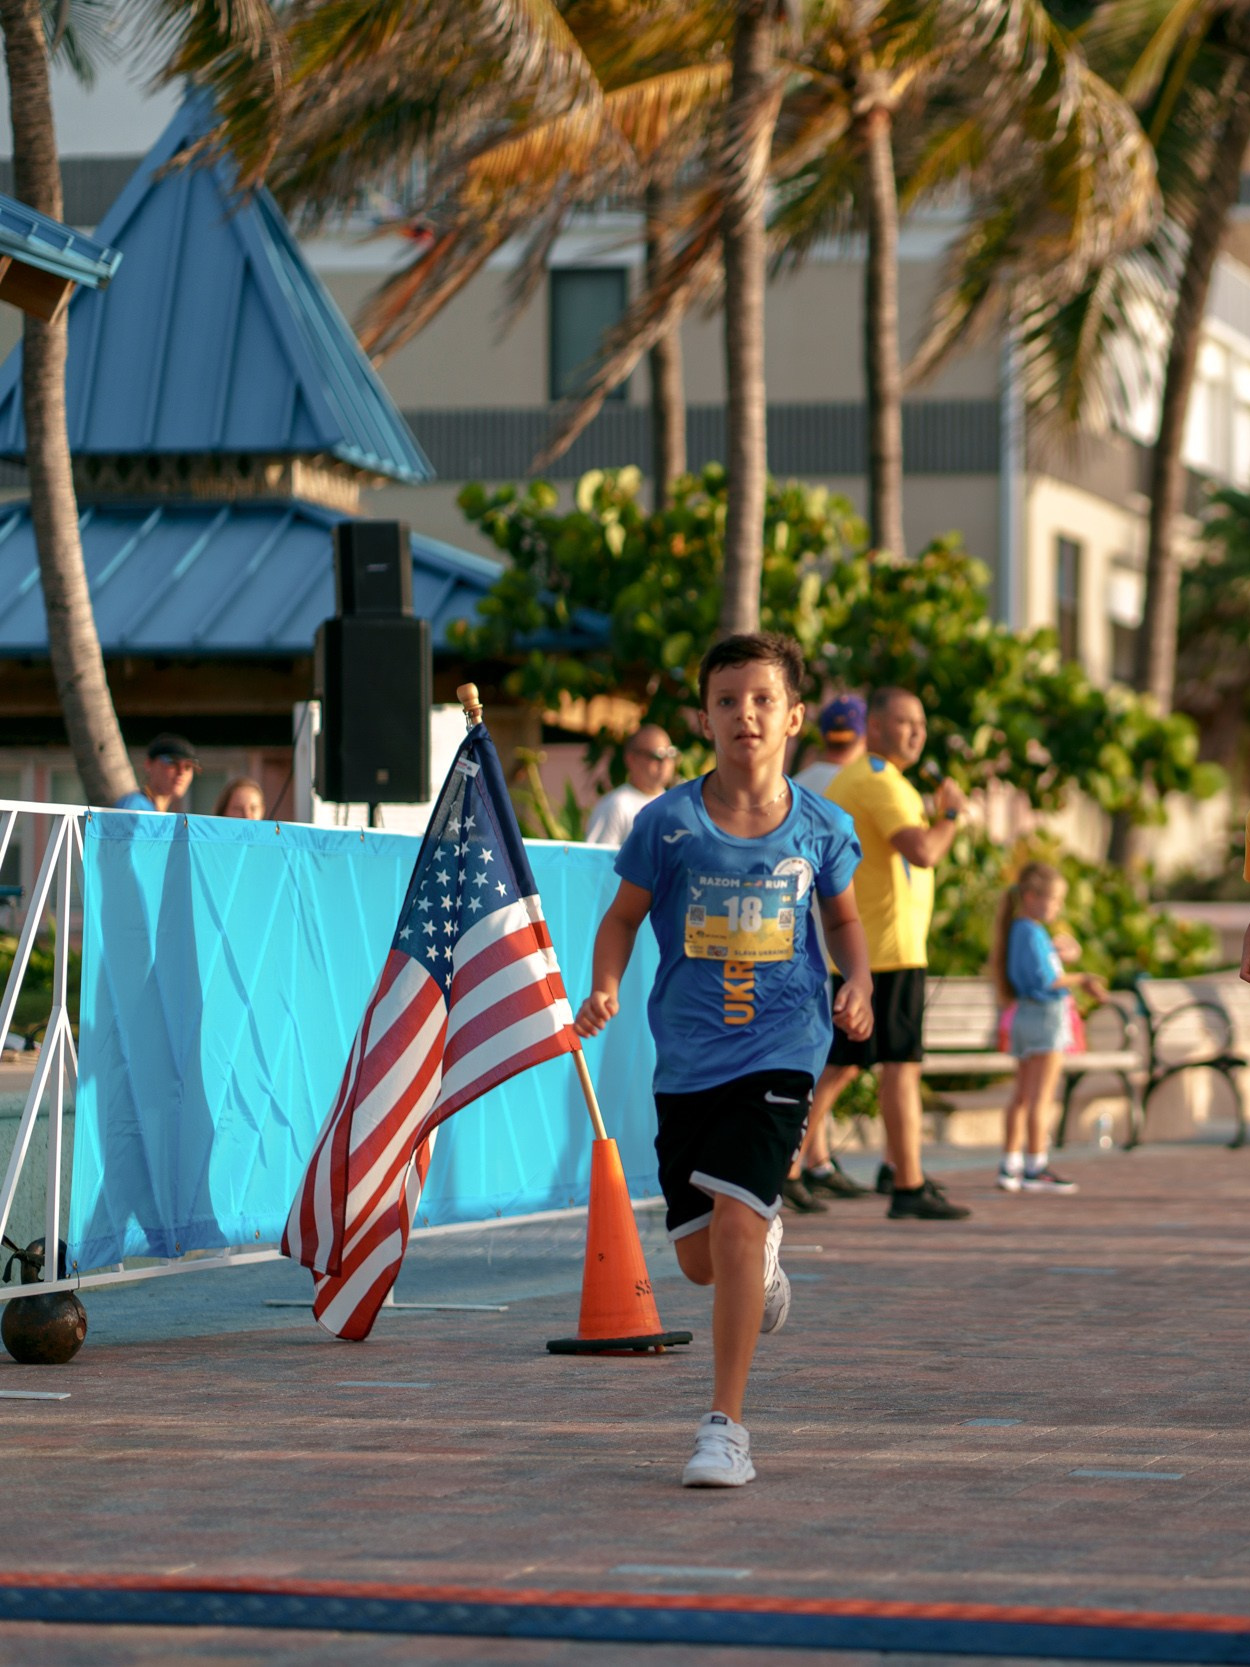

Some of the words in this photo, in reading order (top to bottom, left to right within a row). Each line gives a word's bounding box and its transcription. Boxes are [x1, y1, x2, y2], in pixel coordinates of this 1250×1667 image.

[700, 876, 740, 888] RAZOM
[765, 880, 788, 889] RUN
[723, 896, 763, 932] 18
